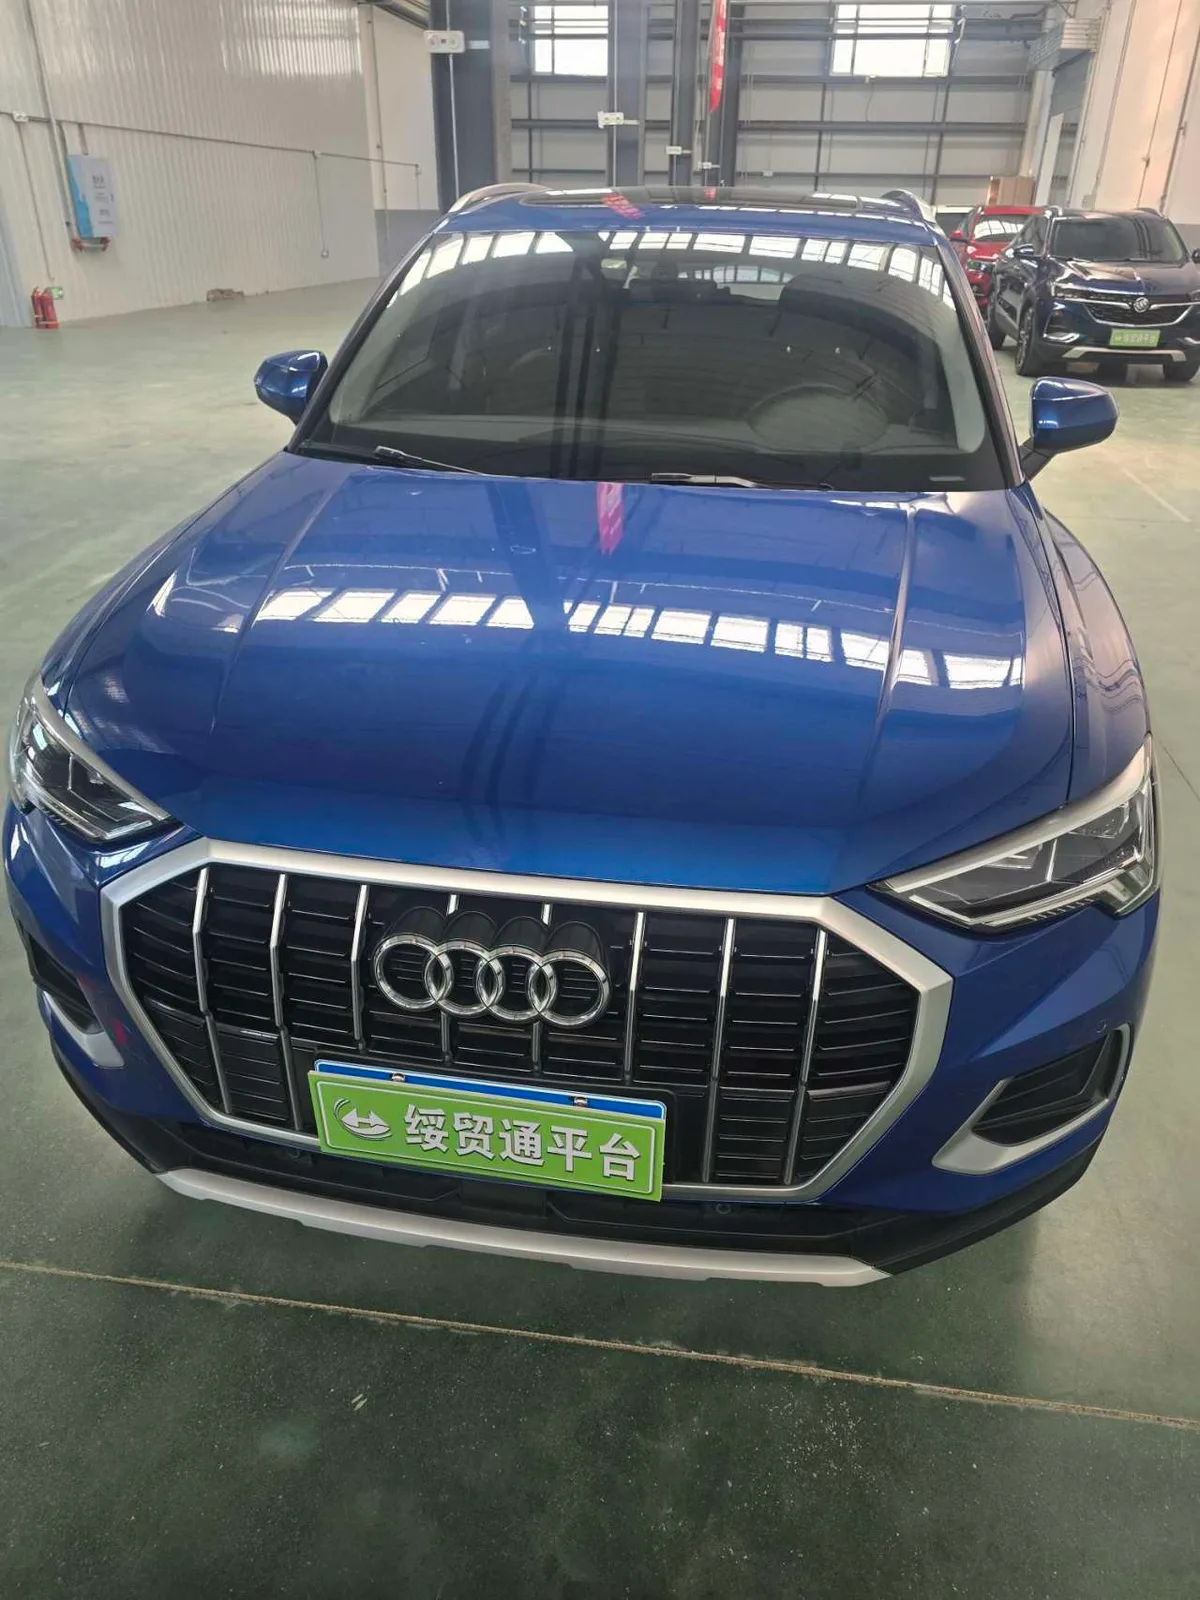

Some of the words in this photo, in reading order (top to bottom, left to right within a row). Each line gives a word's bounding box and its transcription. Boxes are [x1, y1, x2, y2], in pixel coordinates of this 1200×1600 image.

[403, 1104, 641, 1181] 绥贸通平台
